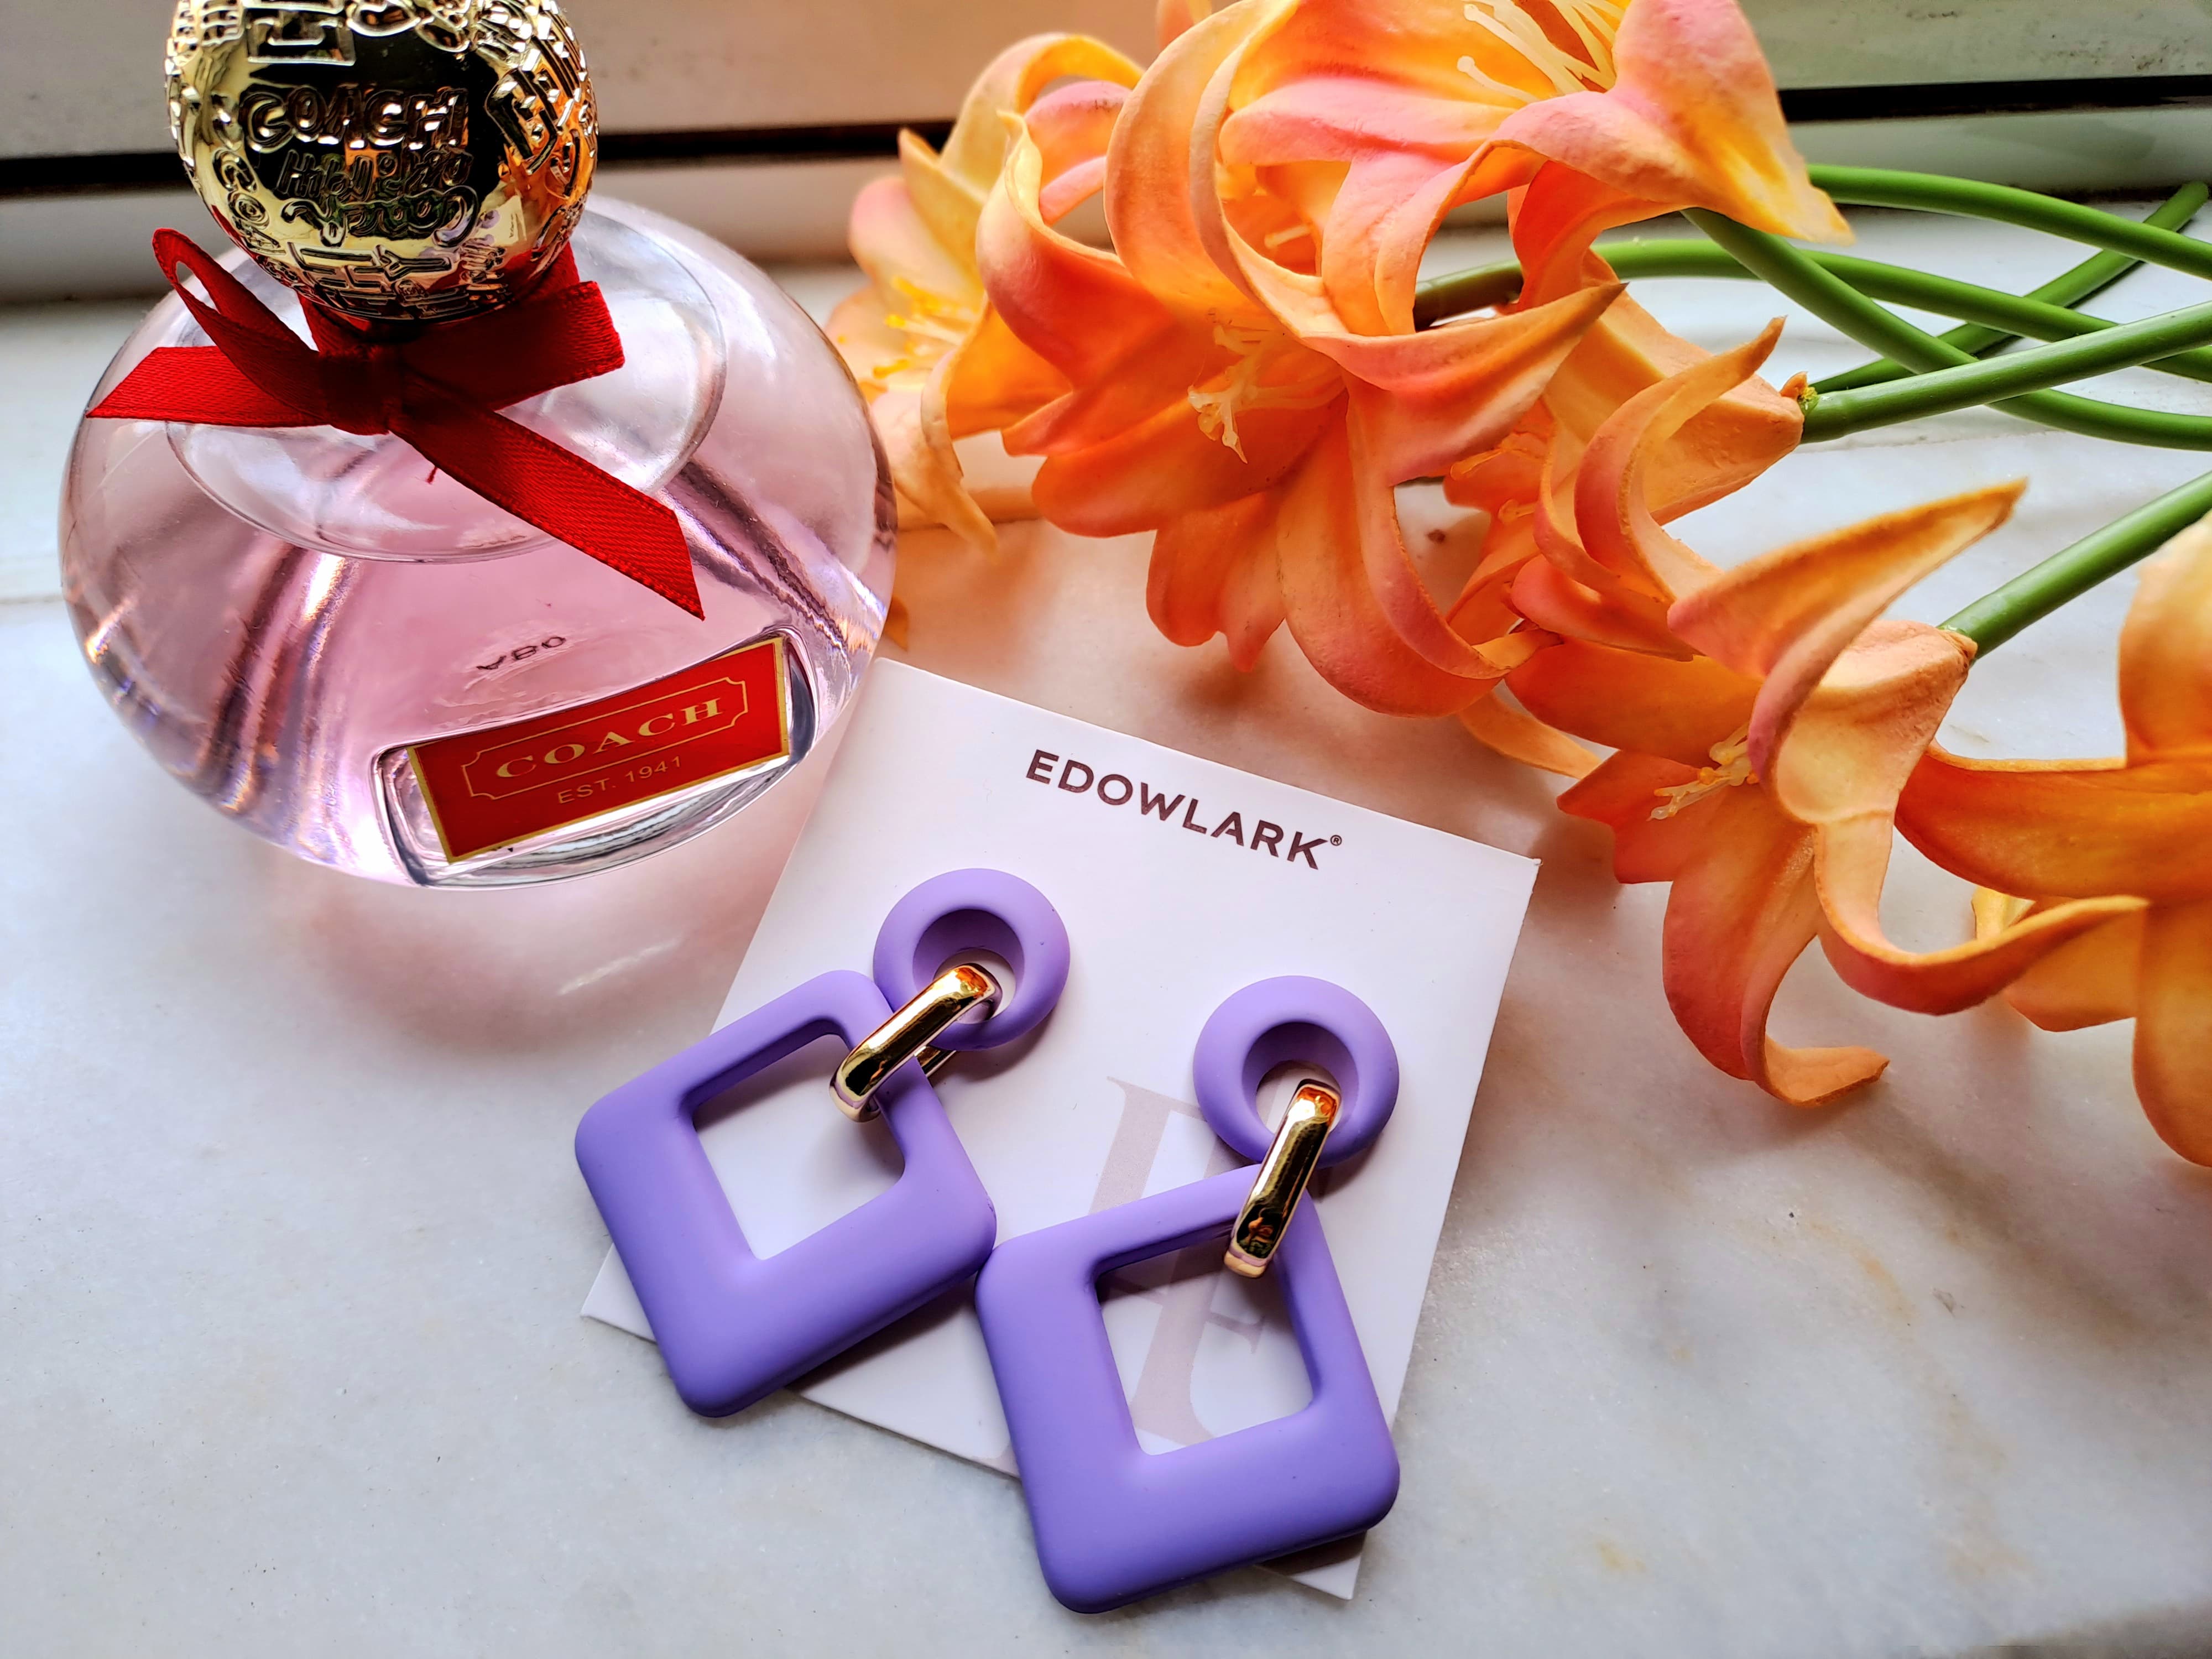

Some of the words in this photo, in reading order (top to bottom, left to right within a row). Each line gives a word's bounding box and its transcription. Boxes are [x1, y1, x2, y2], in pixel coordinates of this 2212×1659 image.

[496, 698, 723, 778] COACH
[557, 778, 617, 805] EST.
[625, 756, 681, 783] 1941
